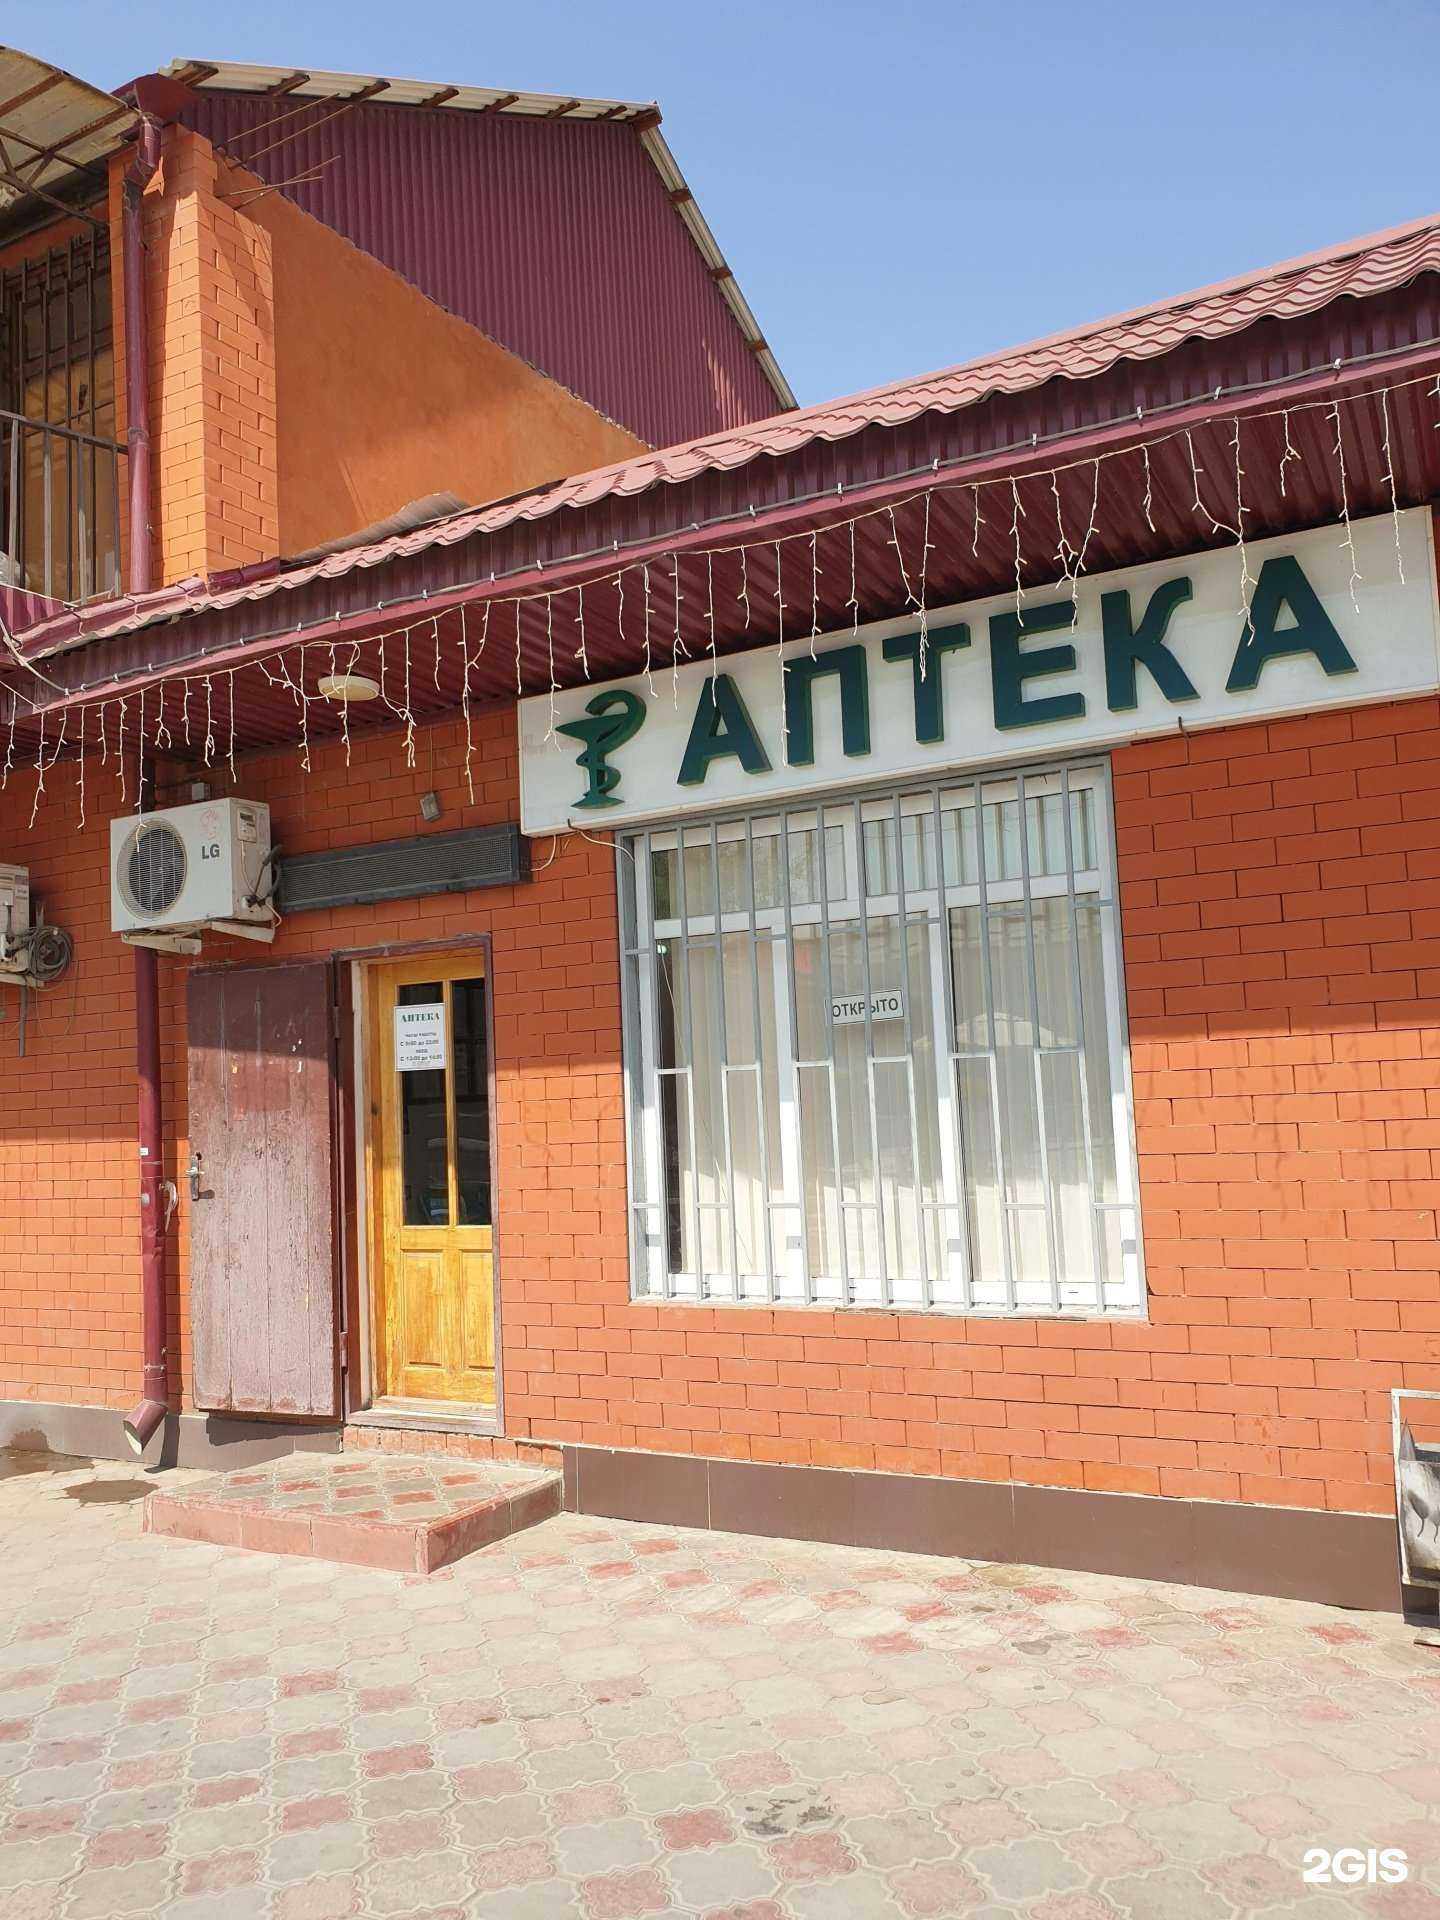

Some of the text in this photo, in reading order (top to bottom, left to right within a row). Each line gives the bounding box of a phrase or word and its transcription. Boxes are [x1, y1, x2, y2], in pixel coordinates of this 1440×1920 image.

[676, 554, 1359, 787] АПТЕКА
[201, 843, 220, 860] LG
[832, 998, 899, 1018] ОТКРЫТО
[401, 1012, 441, 1023] АПТЕКА
